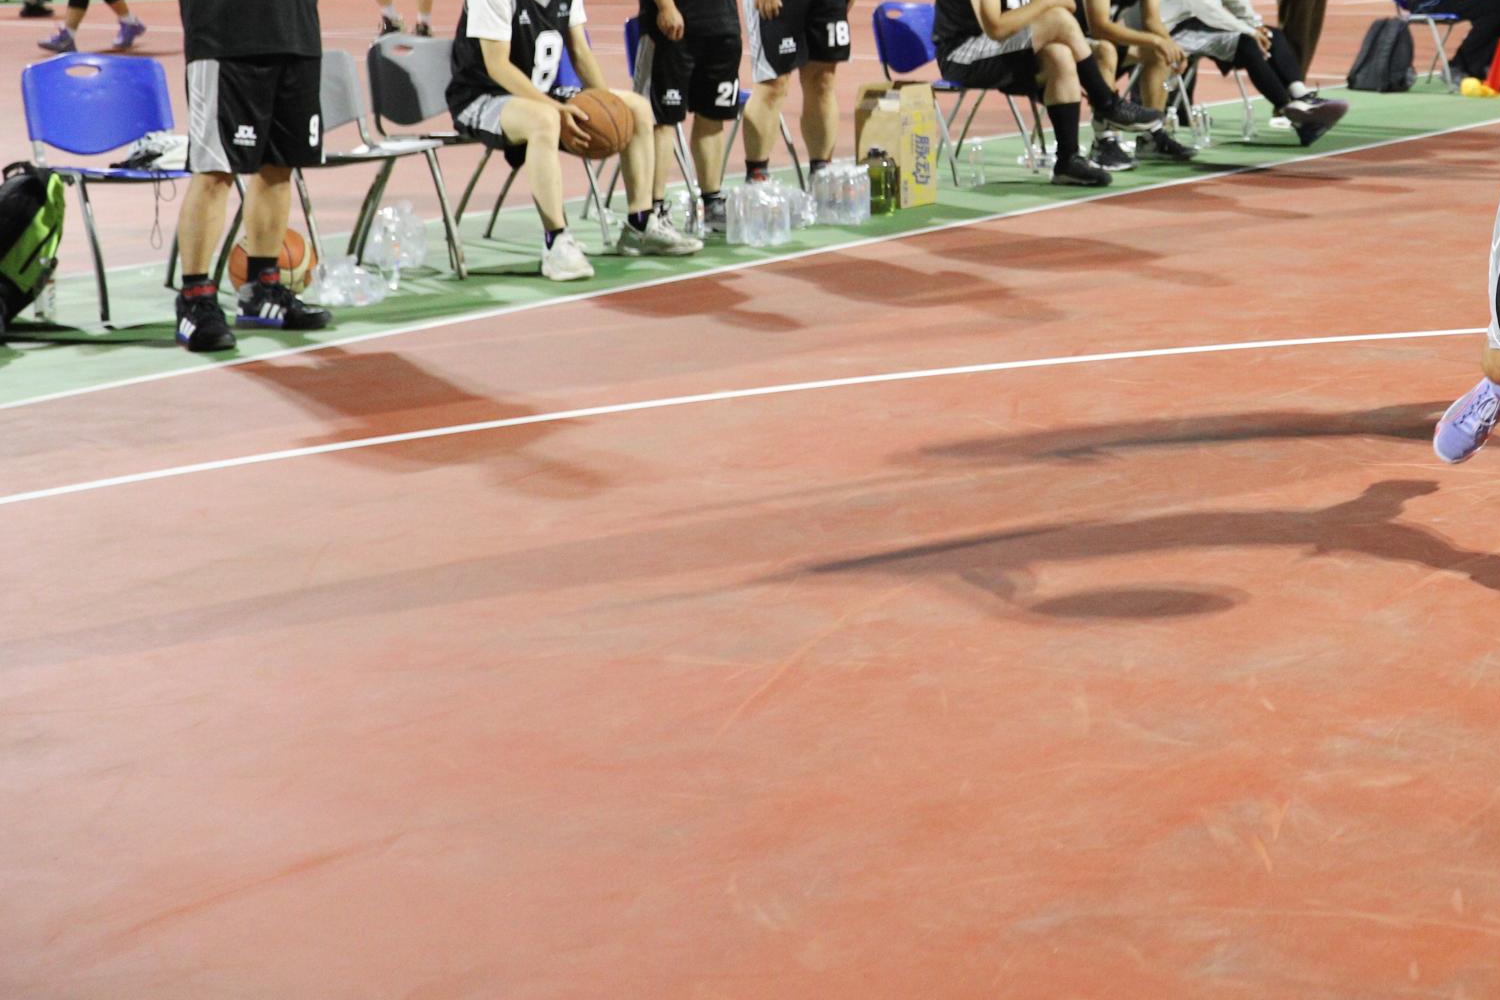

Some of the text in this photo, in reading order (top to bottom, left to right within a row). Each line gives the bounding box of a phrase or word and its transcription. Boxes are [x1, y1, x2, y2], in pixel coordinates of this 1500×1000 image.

[825, 20, 850, 48] 18
[531, 29, 563, 93] 8
[309, 114, 320, 147] 9
